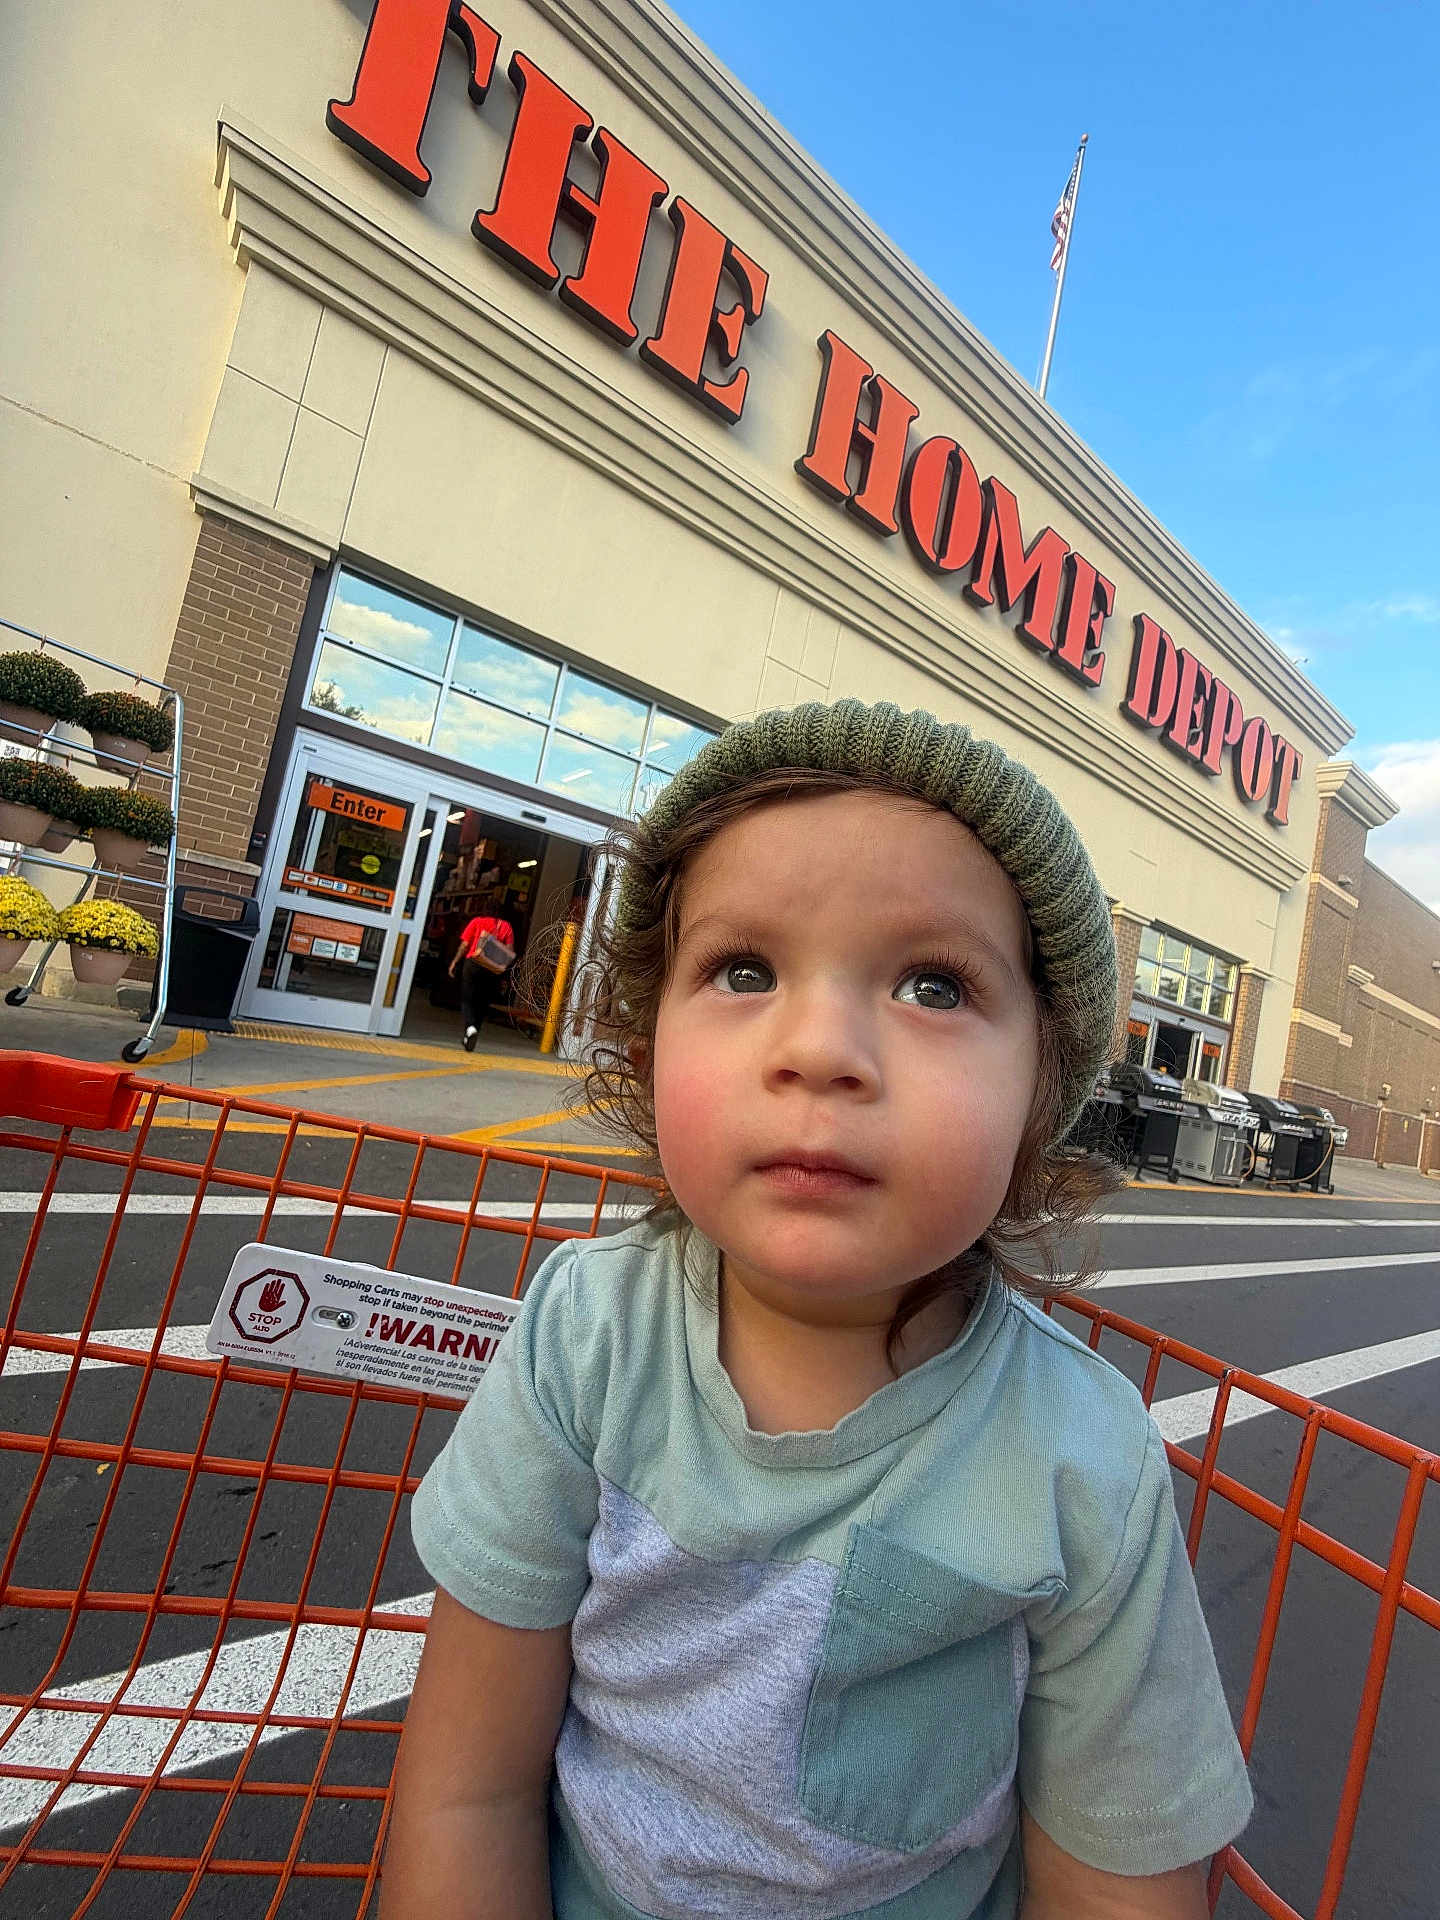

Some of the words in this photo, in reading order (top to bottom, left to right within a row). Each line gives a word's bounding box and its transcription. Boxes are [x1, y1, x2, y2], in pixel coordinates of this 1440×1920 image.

[325, 0, 769, 425] THE
[795, 329, 1116, 687] HOME
[1119, 612, 1303, 825] DEPOT
[330, 791, 387, 822] Enter
[323, 1273, 372, 1293] Shopping
[374, 1284, 400, 1298] Carts
[401, 1290, 423, 1304] may
[423, 1295, 444, 1308] stop
[446, 1301, 508, 1323] unexpectedly
[358, 1294, 381, 1307] stop
[382, 1297, 392, 1308] if
[392, 1302, 418, 1314] taken
[420, 1306, 456, 1322] beyond
[456, 1314, 473, 1325] the
[248, 1312, 282, 1326] STOP
[252, 1324, 270, 1333] ALTO
[401, 1350, 417, 1360] Los
[418, 1355, 445, 1366] carros
[446, 1359, 458, 1369] de
[458, 1361, 467, 1371] la
[344, 1361, 362, 1371] son
[362, 1364, 398, 1379] llevados
[398, 1371, 421, 1383] fuera
[421, 1376, 436, 1386] del
[410, 1365, 422, 1373] en
[423, 1365, 435, 1376] las
[436, 1369, 470, 1383] puertas
